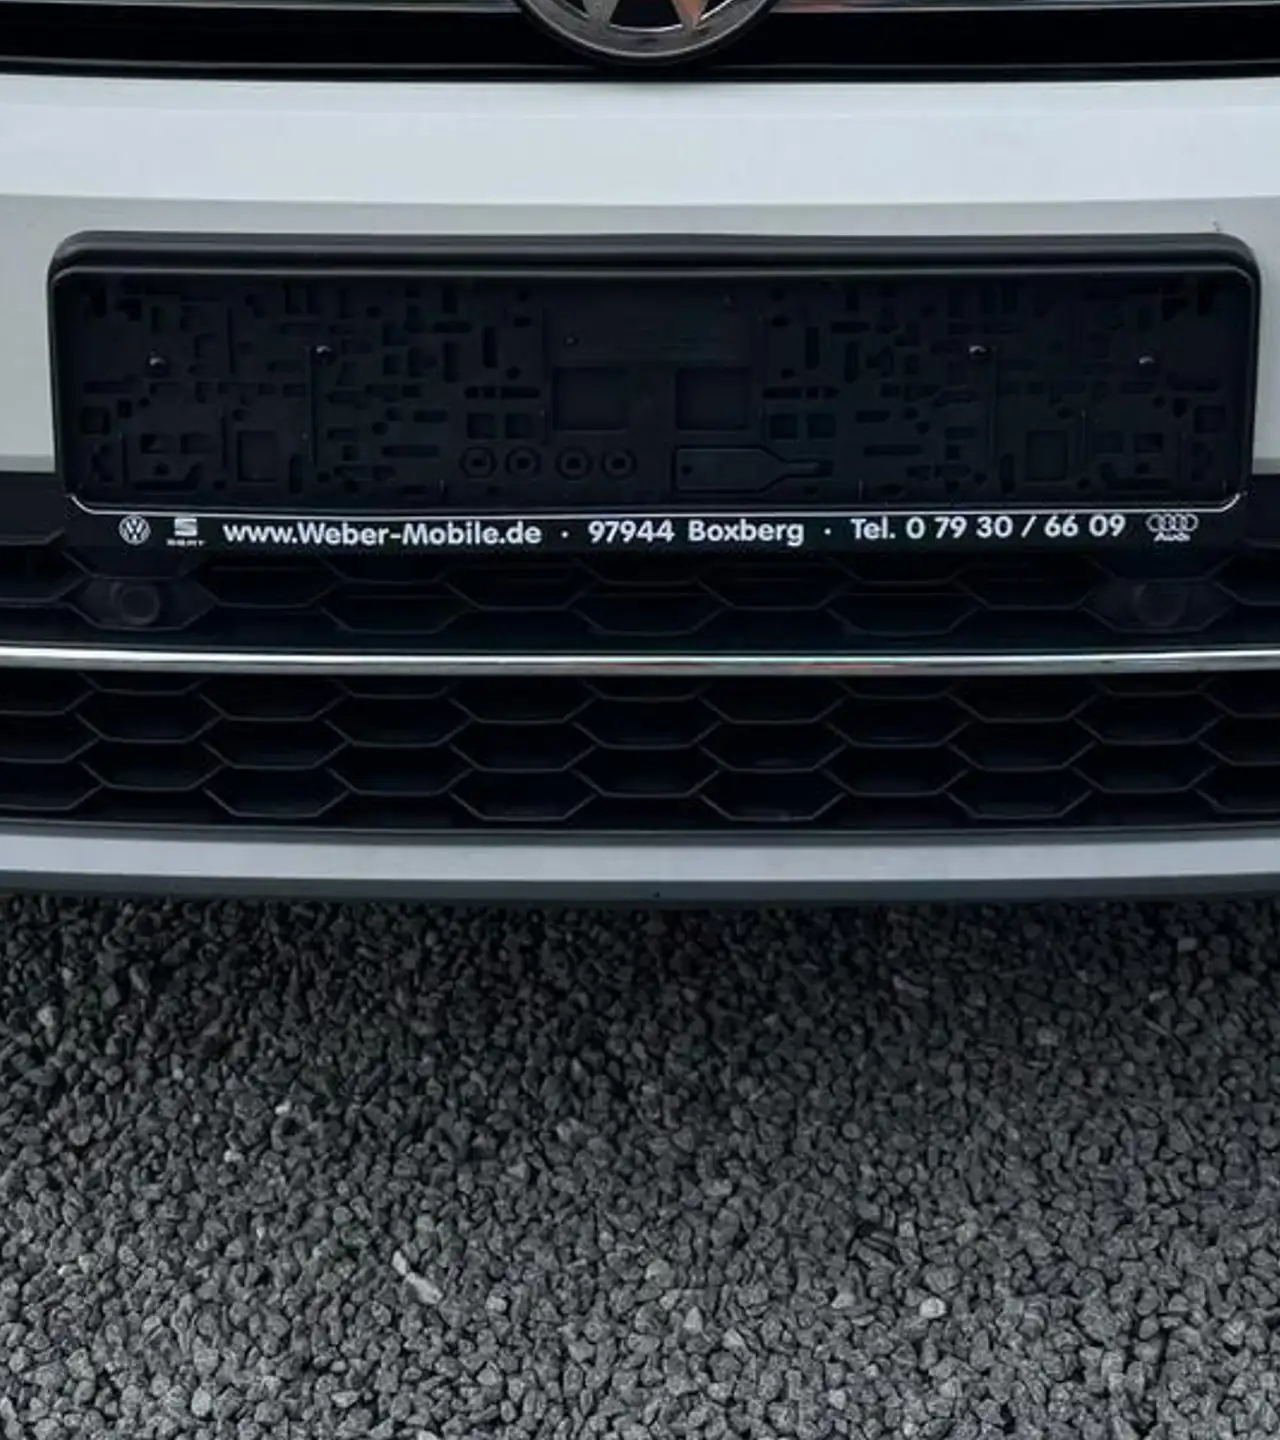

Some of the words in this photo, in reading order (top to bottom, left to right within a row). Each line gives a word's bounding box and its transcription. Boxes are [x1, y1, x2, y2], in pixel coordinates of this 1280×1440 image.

[222, 520, 542, 546] www.Weber-Mobile.de
[587, 519, 676, 544] 97944
[688, 518, 805, 547] Boxberg
[849, 517, 896, 540] Tel.
[906, 515, 926, 540] 0
[934, 515, 968, 539] 79
[976, 515, 1014, 539] 30
[1044, 513, 1079, 538] 66
[1088, 513, 1126, 537] 09
